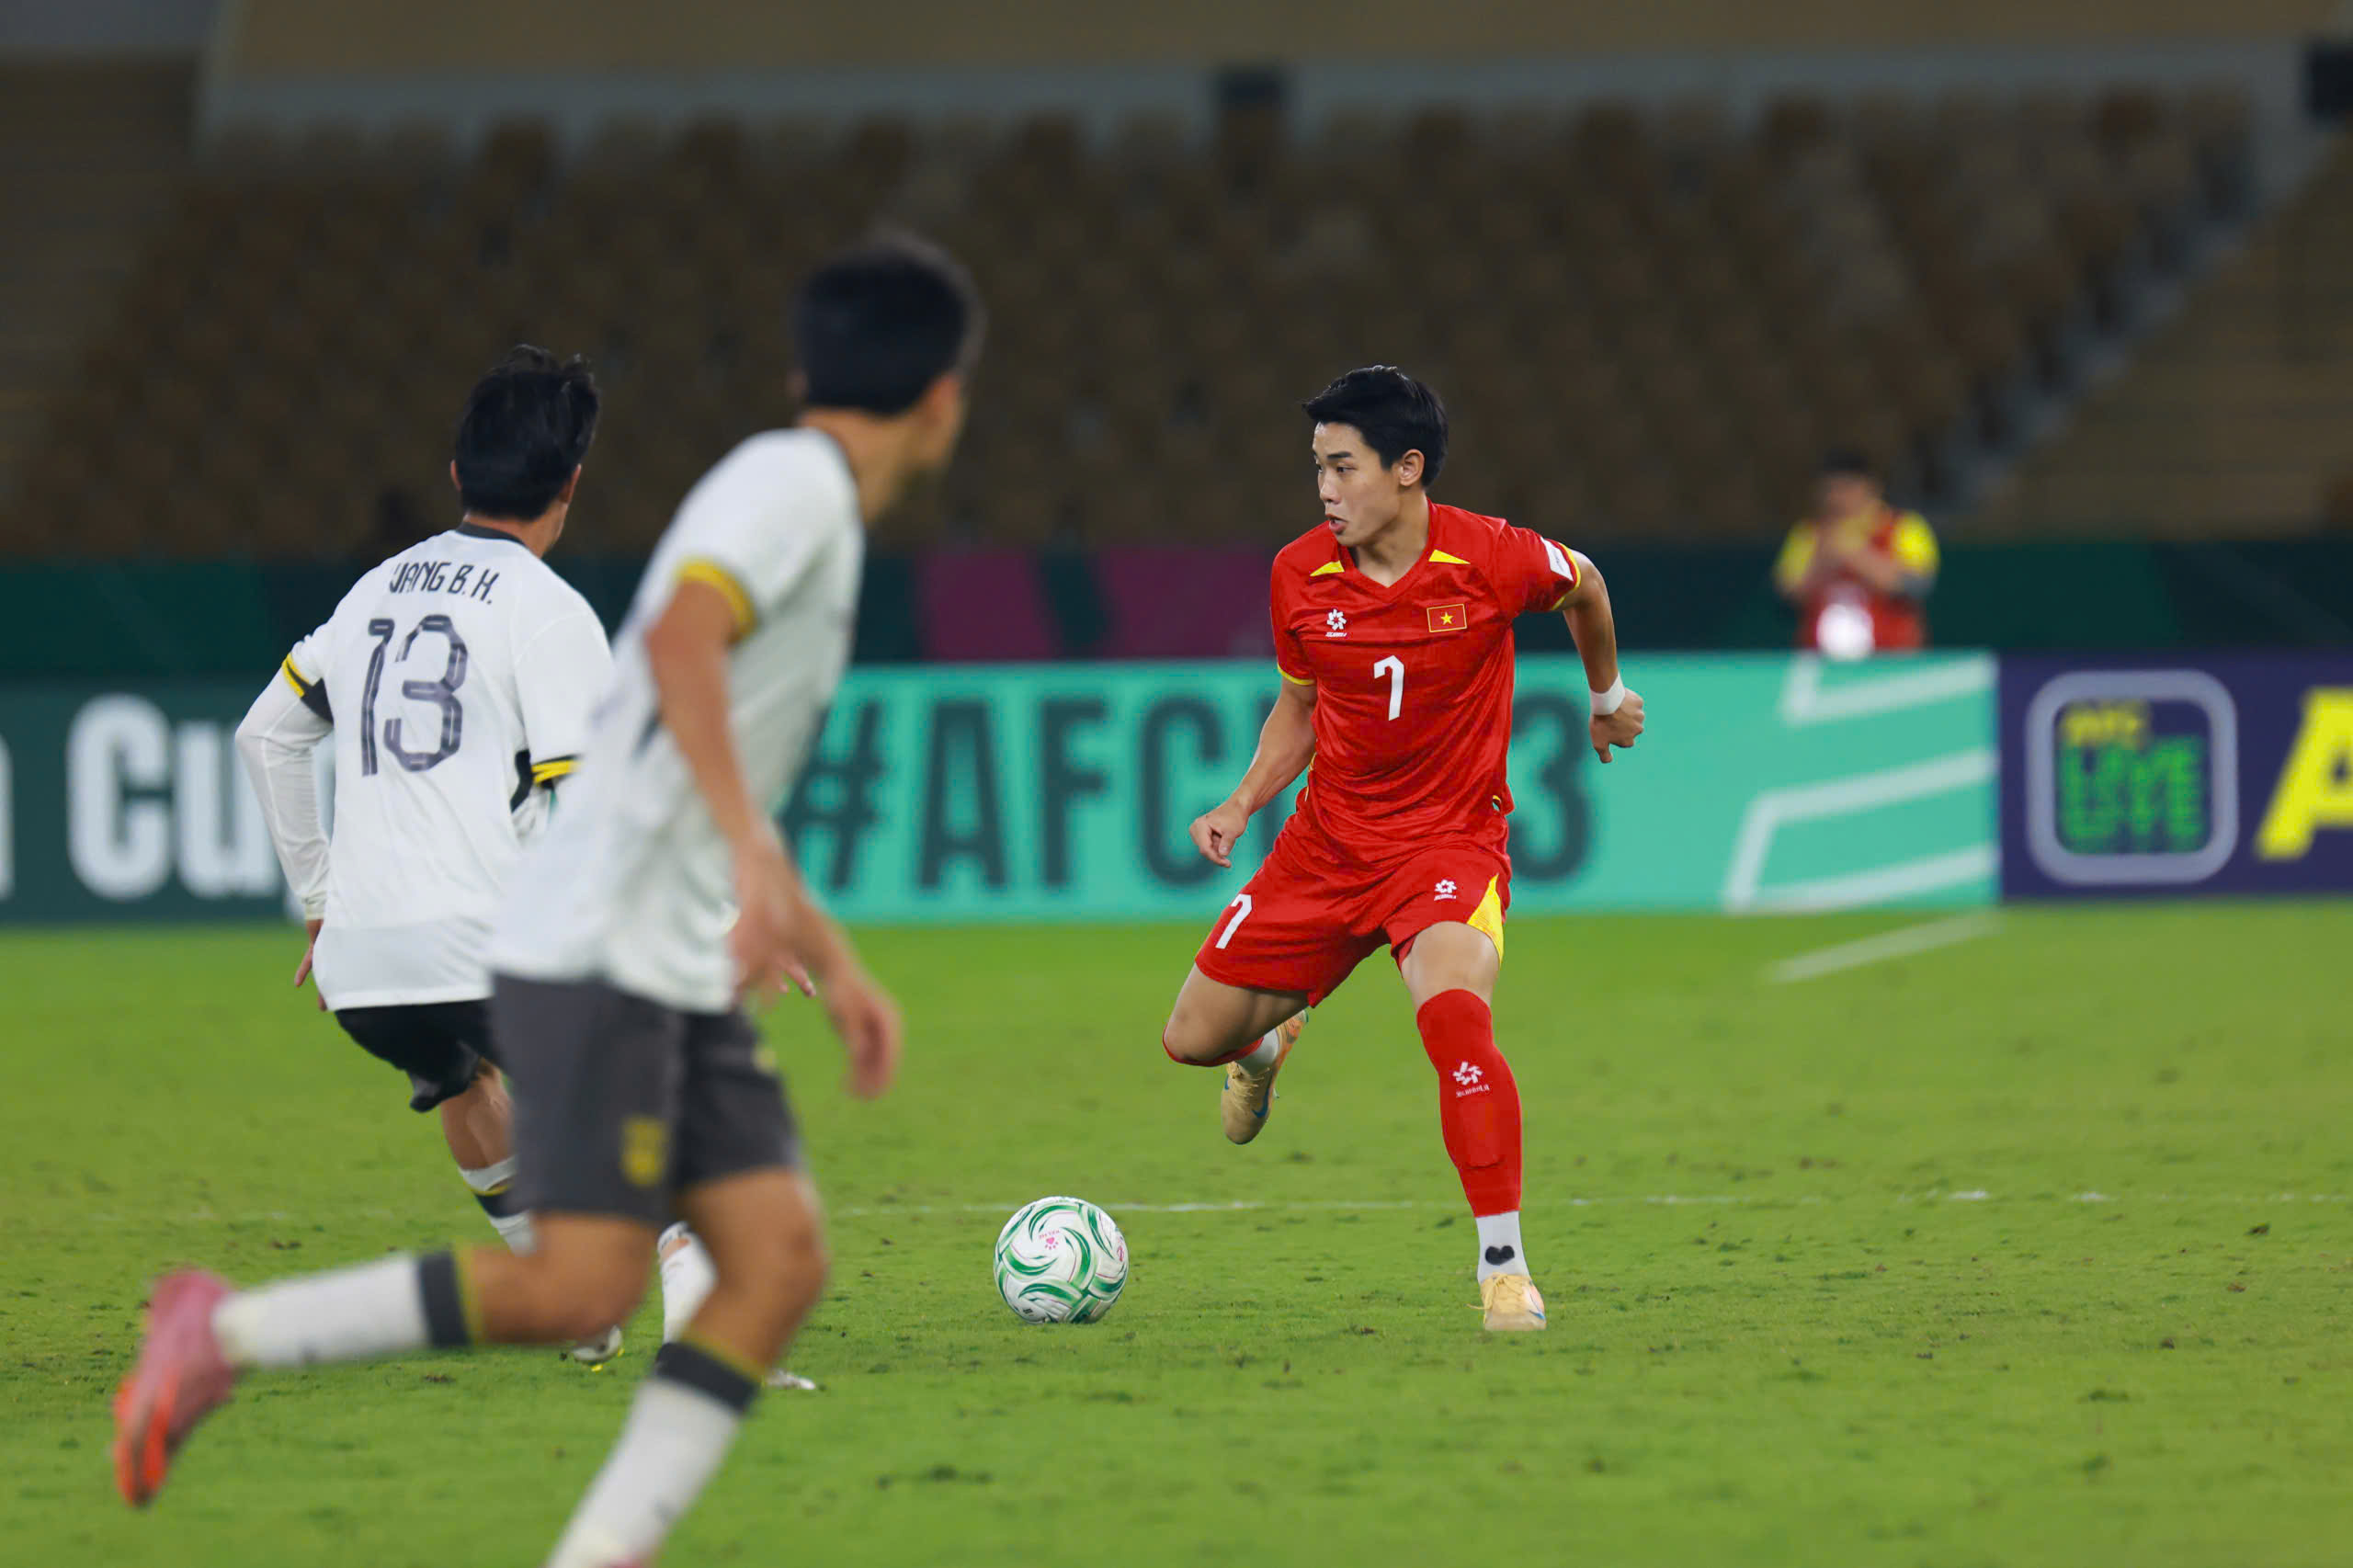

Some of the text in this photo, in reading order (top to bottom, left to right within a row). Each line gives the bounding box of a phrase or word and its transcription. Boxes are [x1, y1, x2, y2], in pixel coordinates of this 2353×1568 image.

[361, 613, 470, 777] 13
[1373, 654, 1405, 722] 7
[65, 691, 335, 919] Cu
[778, 691, 1595, 885] #AFC3
[1215, 892, 1253, 949] 7
